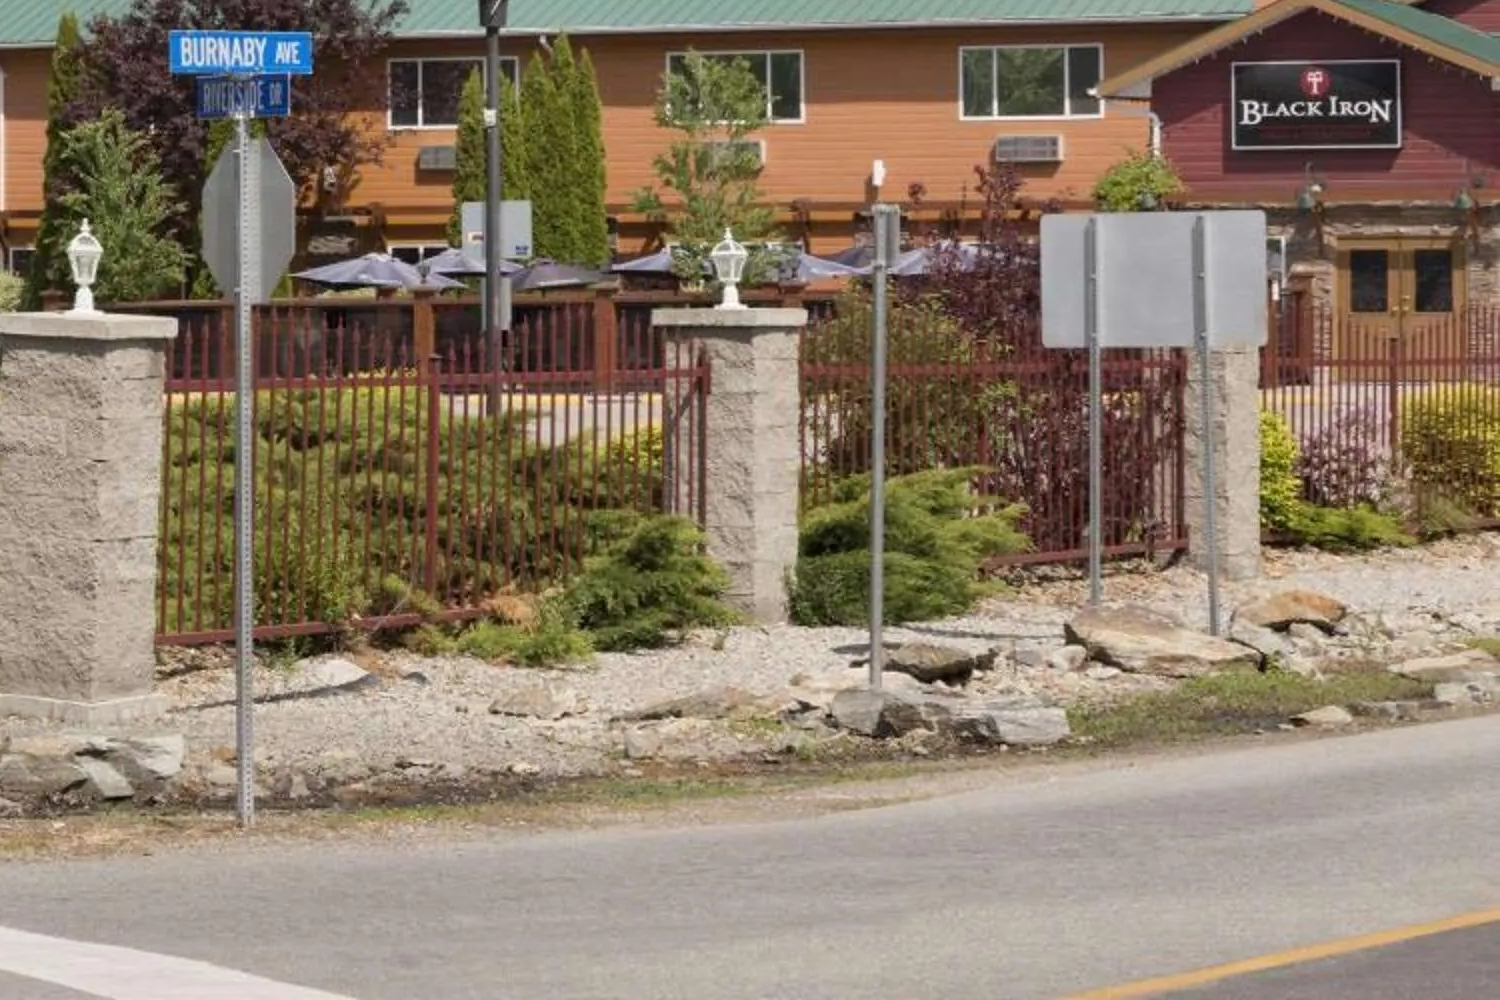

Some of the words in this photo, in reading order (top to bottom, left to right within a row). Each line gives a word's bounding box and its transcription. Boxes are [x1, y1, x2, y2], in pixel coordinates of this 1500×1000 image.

[180, 37, 267, 66] BURNABY
[275, 41, 300, 64] AVE
[203, 80, 265, 112] RIVERSIDE
[1240, 100, 1324, 124] BLACK
[1328, 97, 1392, 122] IRON
